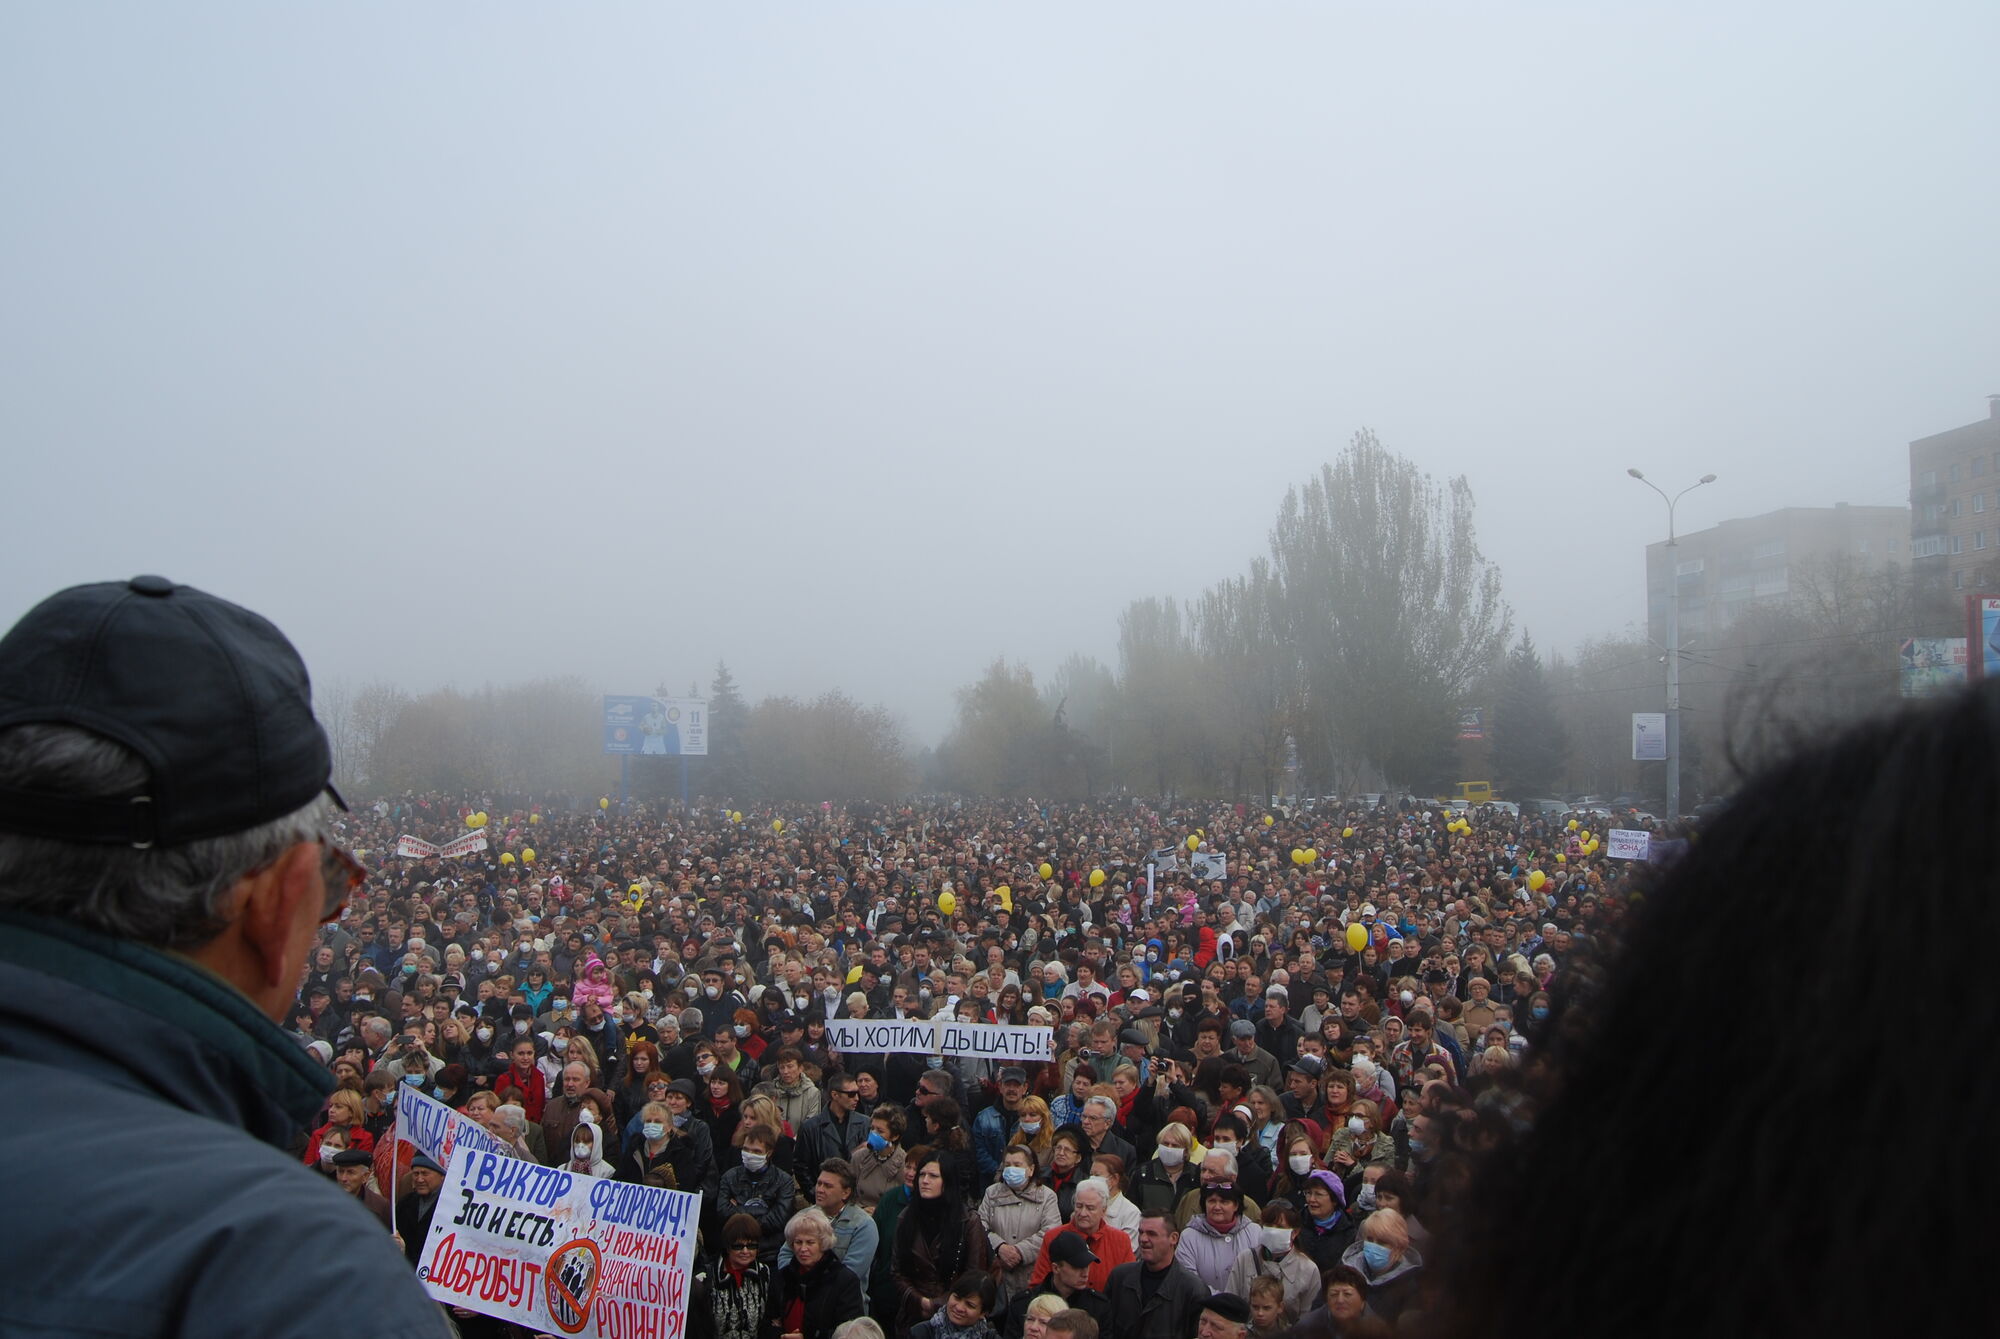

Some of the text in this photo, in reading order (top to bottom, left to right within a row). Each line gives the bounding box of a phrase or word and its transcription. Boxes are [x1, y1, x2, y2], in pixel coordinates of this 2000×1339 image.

[826, 1028, 859, 1048] МЫ
[864, 1026, 935, 1049] ХОТИМ
[401, 1089, 450, 1157] ЧИСТЫЙ
[613, 1230, 679, 1267] КОЖНІЙ
[596, 1259, 685, 1310] УКРАЇНСЬКІЙ
